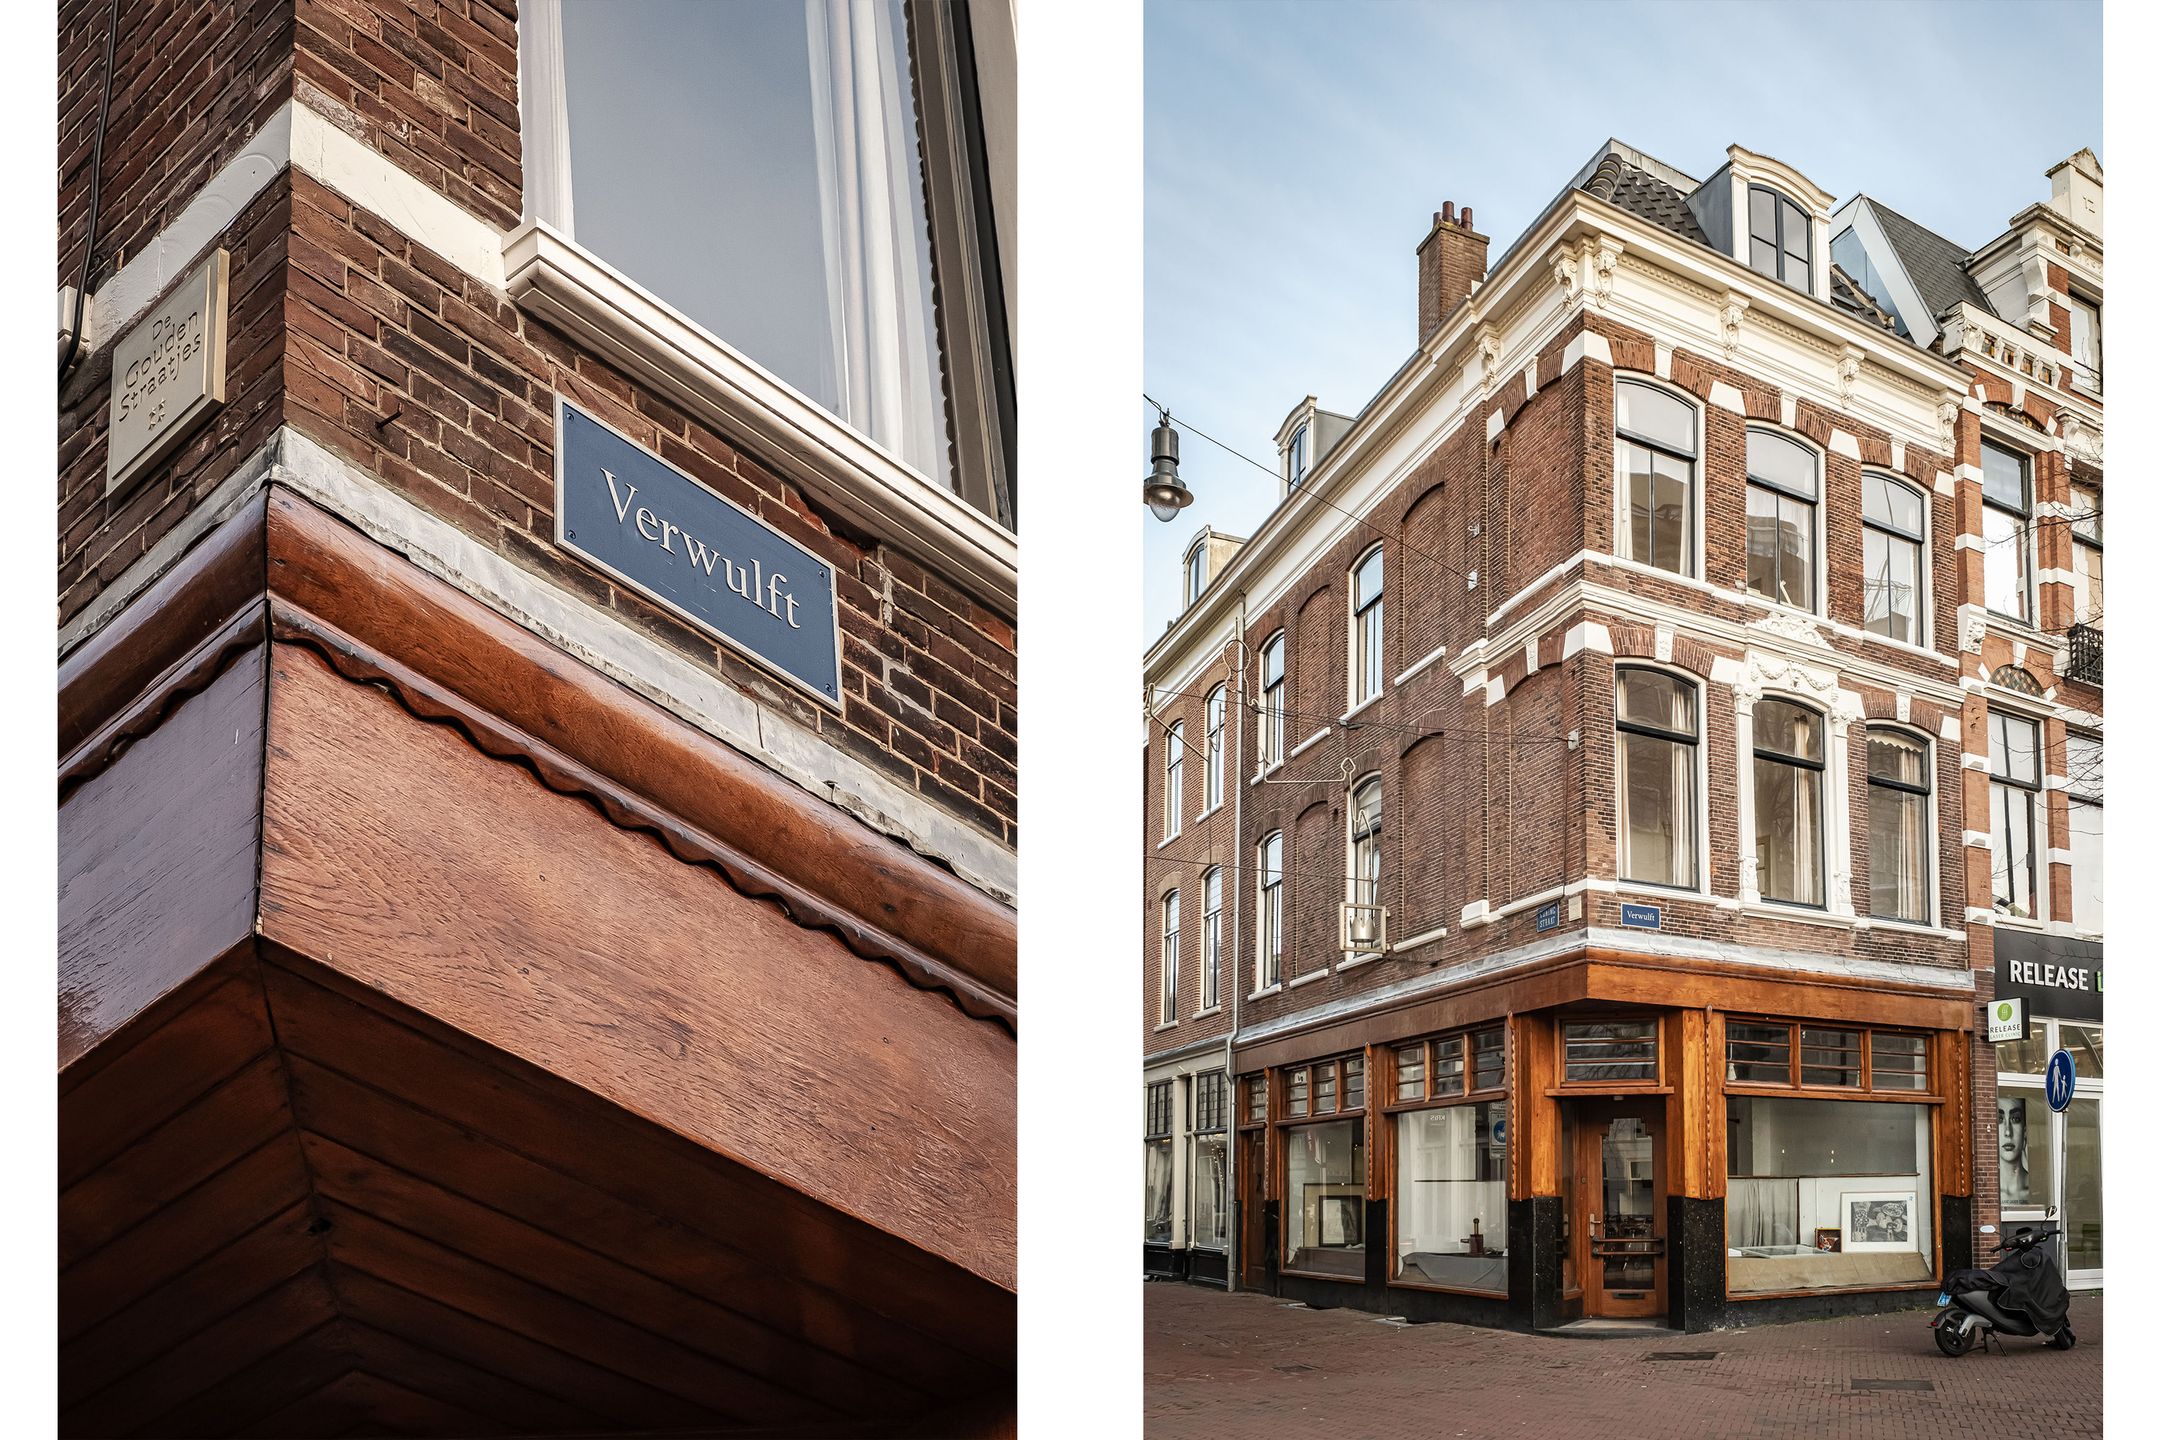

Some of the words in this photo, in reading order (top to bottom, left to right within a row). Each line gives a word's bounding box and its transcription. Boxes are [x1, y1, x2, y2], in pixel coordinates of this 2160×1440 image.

[153, 314, 171, 342] De
[125, 311, 198, 390] Gouden
[119, 333, 201, 422] Straatjes
[600, 467, 801, 629] Verwulft
[1627, 910, 1655, 922] Verwulft
[2009, 960, 2089, 991] RELEASE
[1990, 1024, 2021, 1034] RELEASE
